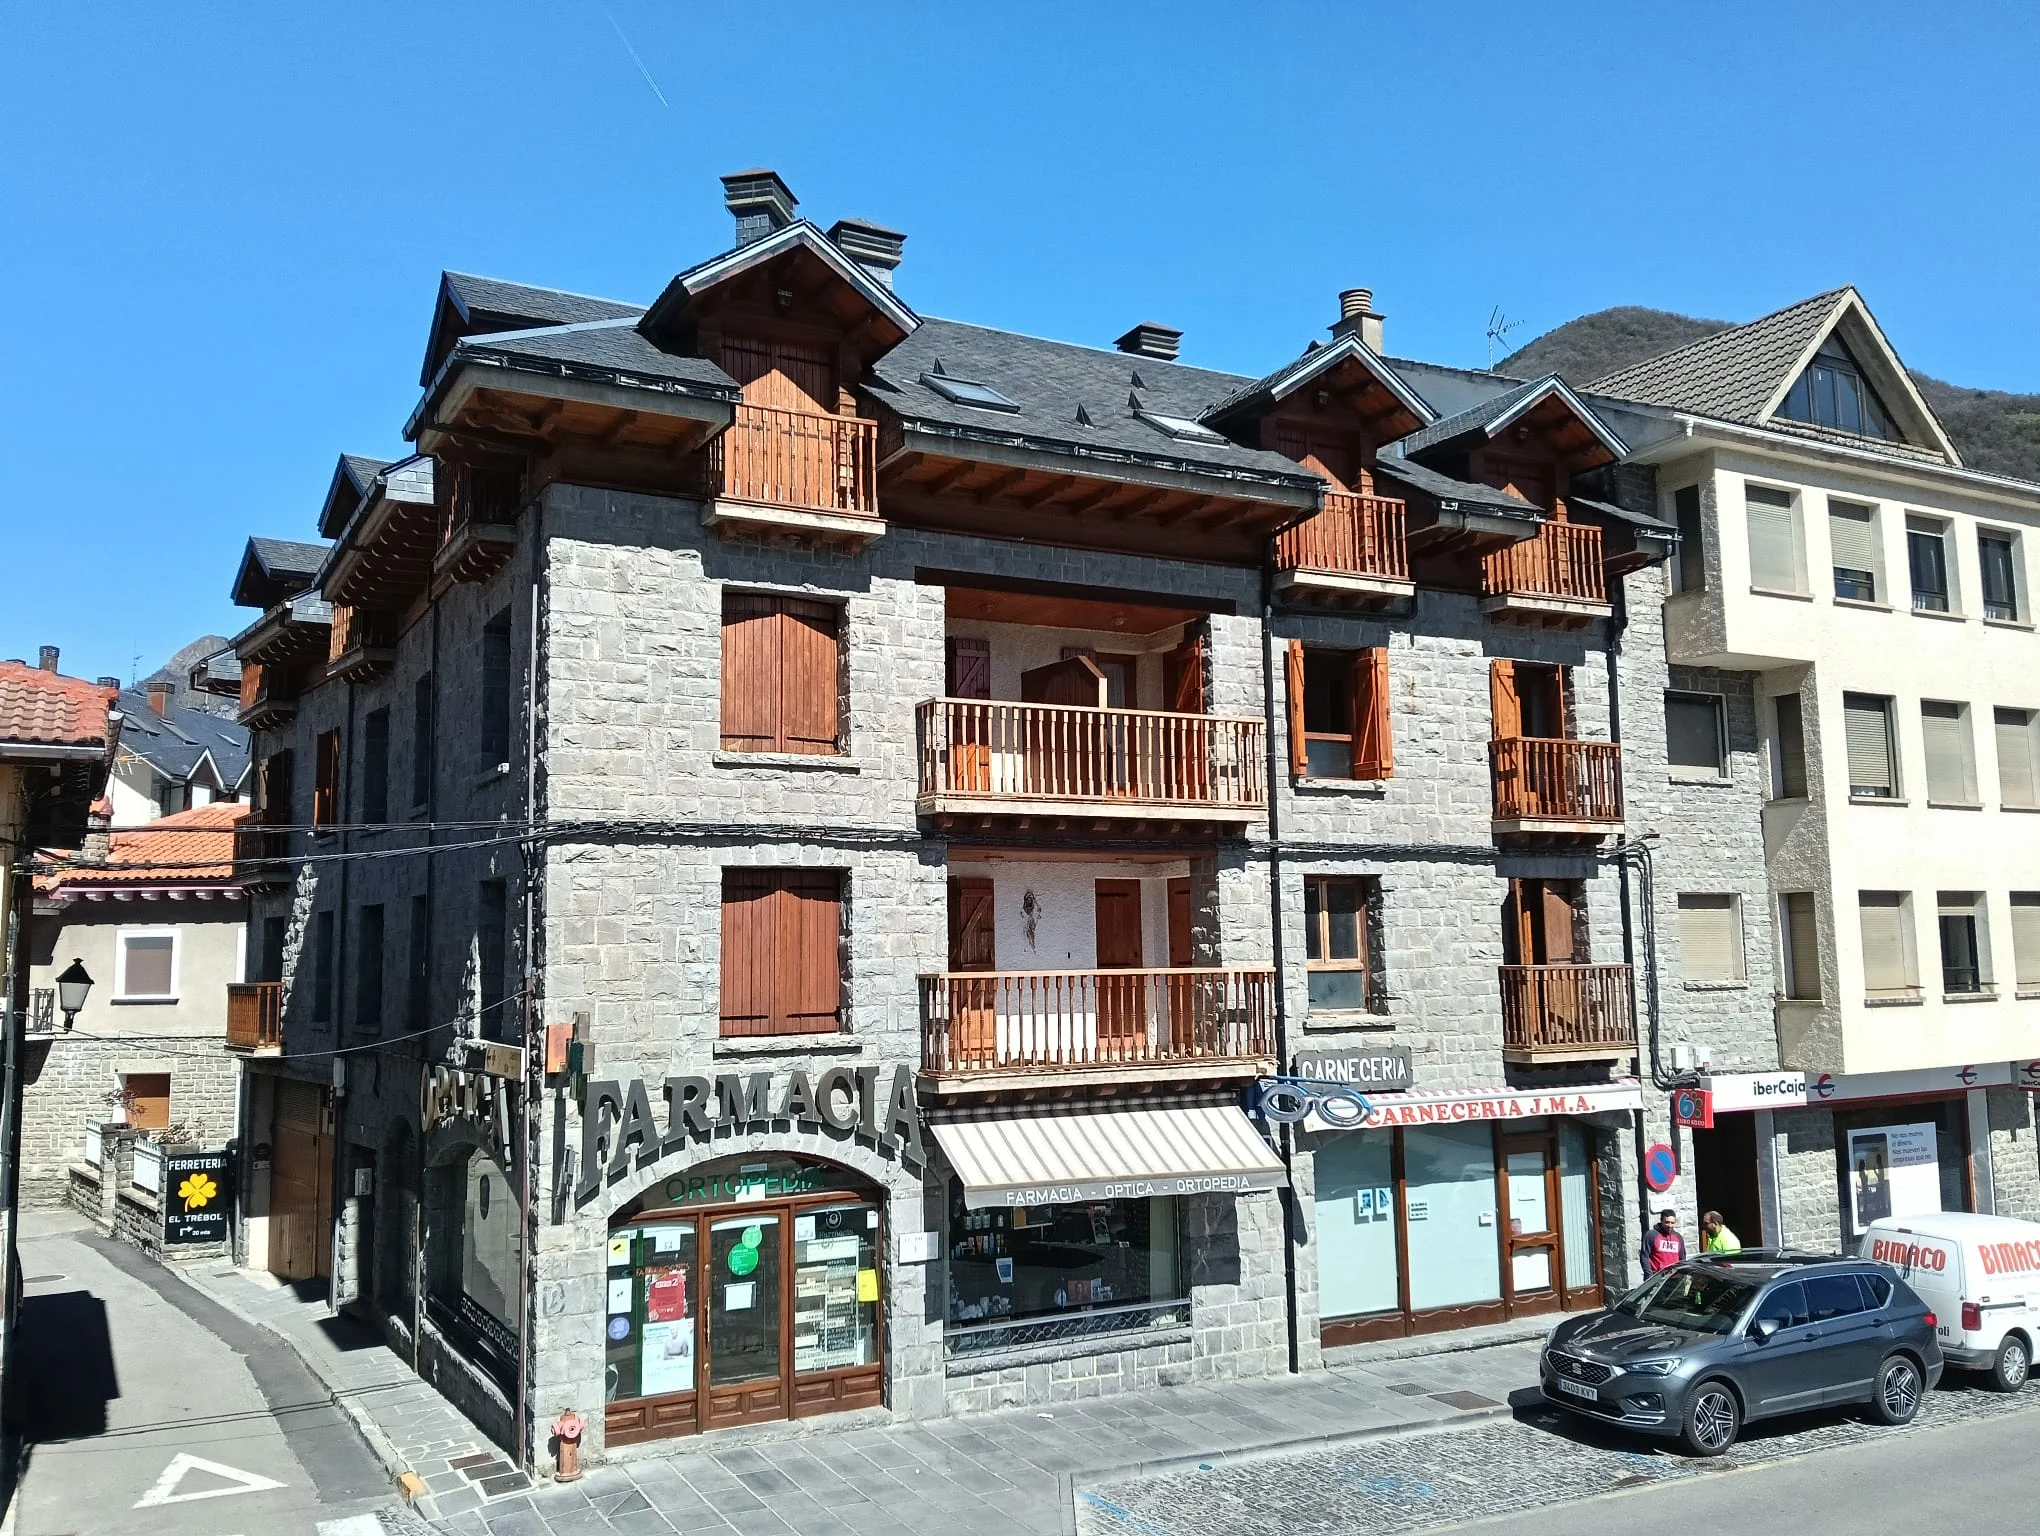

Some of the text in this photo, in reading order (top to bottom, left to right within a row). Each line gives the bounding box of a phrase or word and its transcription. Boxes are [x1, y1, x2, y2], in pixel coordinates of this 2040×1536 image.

[1301, 1056, 1408, 1084] CARNECERIA
[1753, 1079, 1806, 1096] iberCaja
[1366, 1095, 1596, 1126] CARNECERIA J.M.A.
[575, 1063, 928, 1204] FARMACIA
[168, 1158, 228, 1171] FERRETERIA
[665, 1167, 825, 1203] ORTOPEDIA
[1006, 1186, 1083, 1206] FARMACIA
[1104, 1182, 1155, 1198] OPTICA
[1176, 1176, 1250, 1192] ORTOPEDIA
[168, 1215, 181, 1223] EL
[1873, 1239, 1946, 1271] BIMACO
